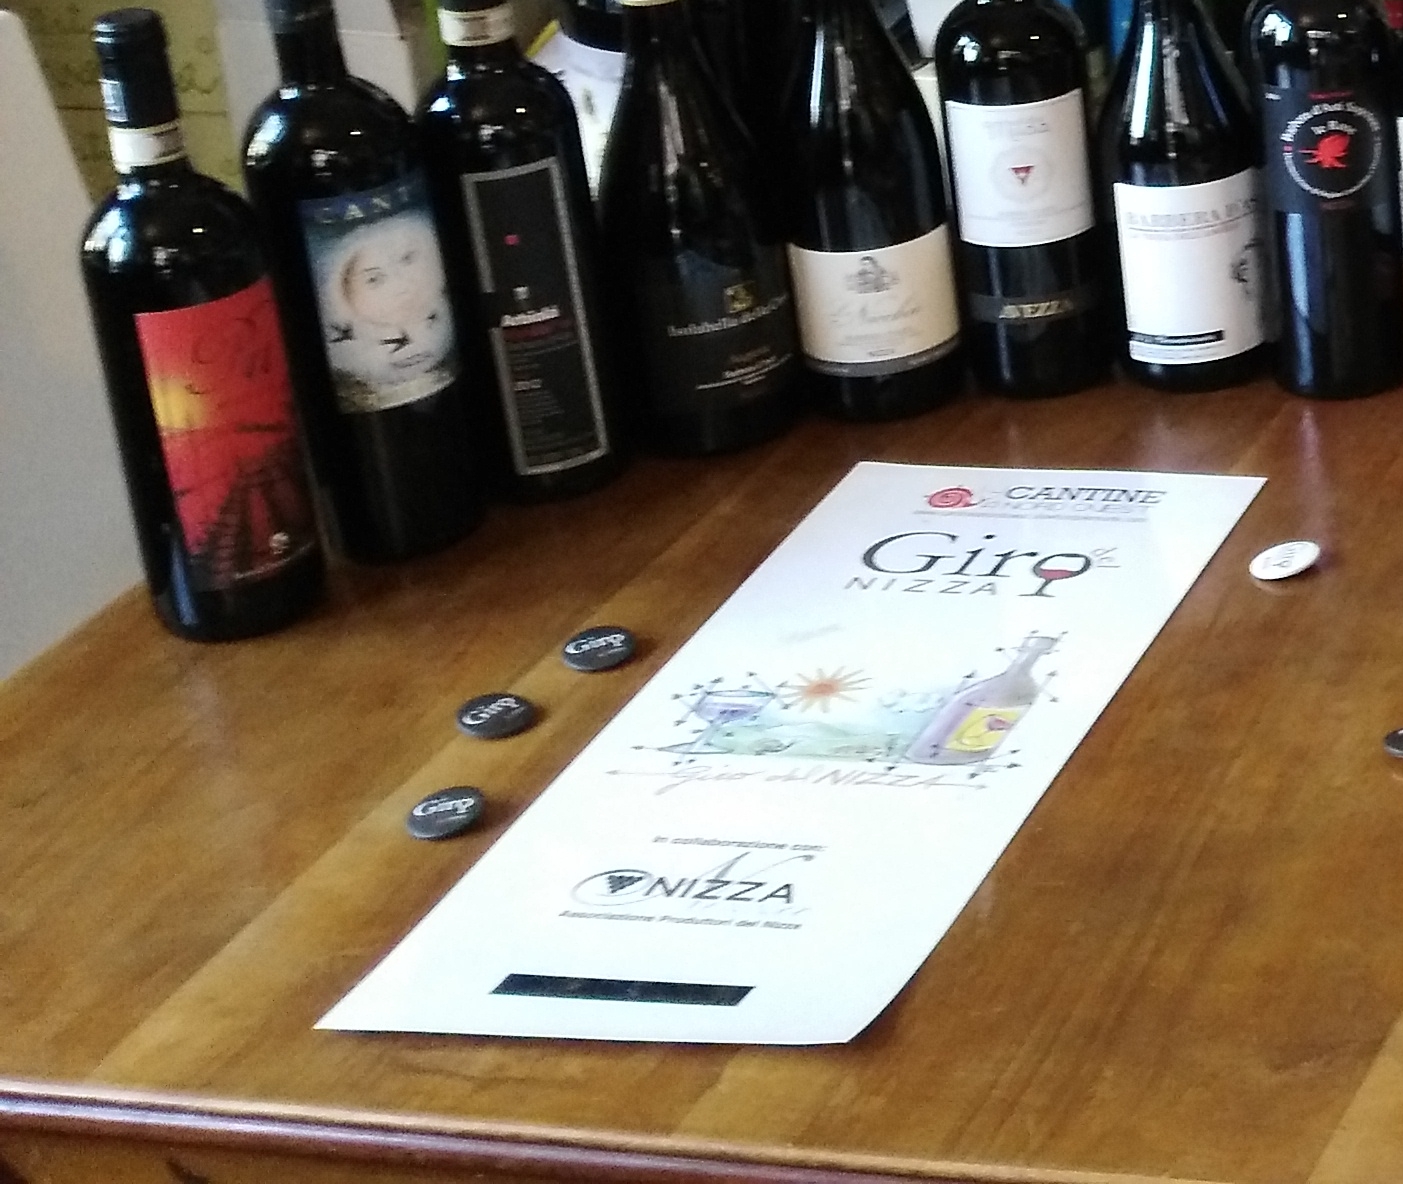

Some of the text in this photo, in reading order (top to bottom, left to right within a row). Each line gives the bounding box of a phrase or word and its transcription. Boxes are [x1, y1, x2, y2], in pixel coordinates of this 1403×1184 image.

[1005, 486, 1168, 505] CANTINE
[862, 531, 1091, 598] Giro
[843, 575, 1000, 596] NIZZA
[564, 633, 626, 654] Giro
[643, 876, 796, 905] NIZZA
